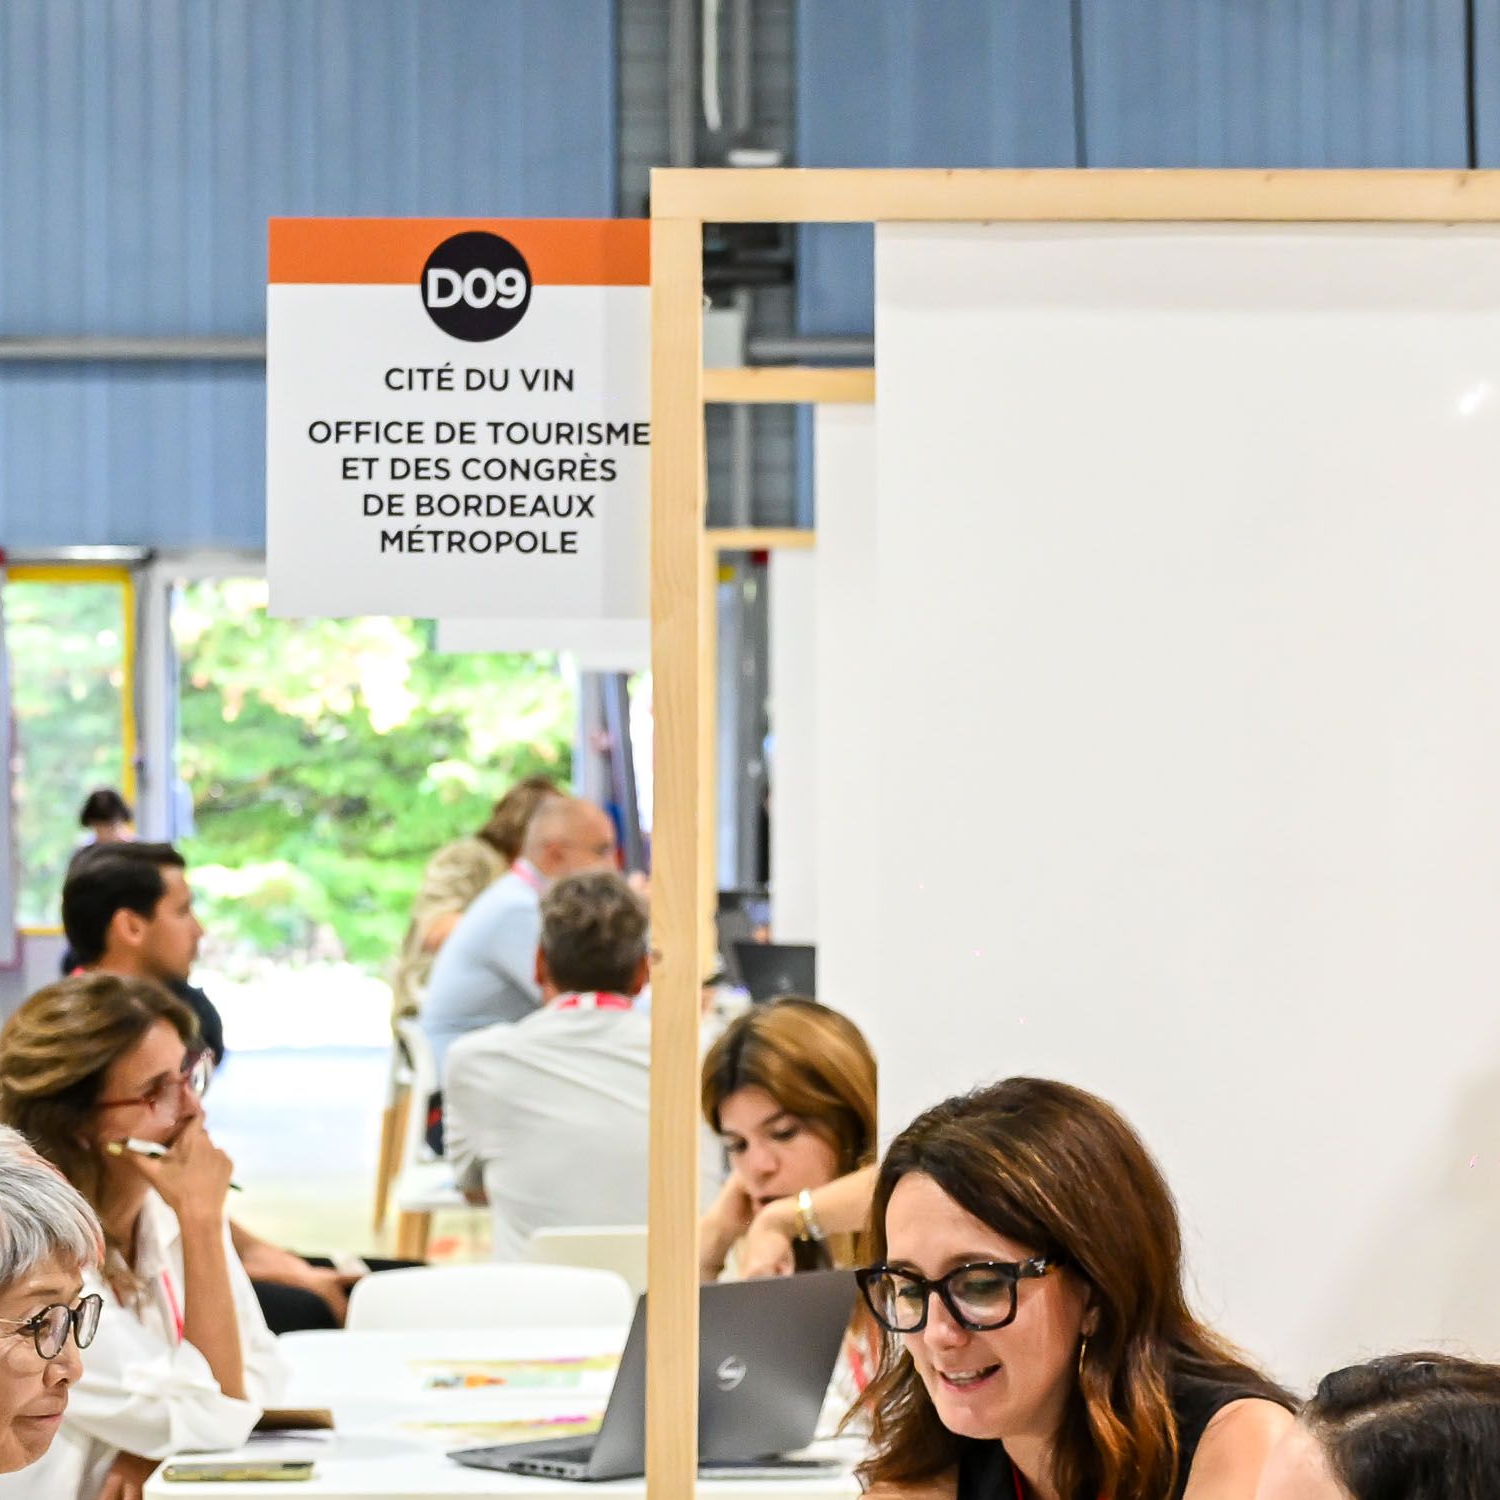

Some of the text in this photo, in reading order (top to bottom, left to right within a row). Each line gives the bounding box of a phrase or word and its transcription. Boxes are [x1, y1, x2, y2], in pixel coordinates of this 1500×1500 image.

[427, 268, 526, 308] D09
[385, 363, 574, 391] CITÉ DU VIN
[308, 421, 651, 446] OFFICE DE TOURISME
[342, 452, 617, 482] ET DES CONGRÈS
[363, 494, 595, 518] DE BORDEAUX
[381, 526, 578, 554] MÉTROPOLE
